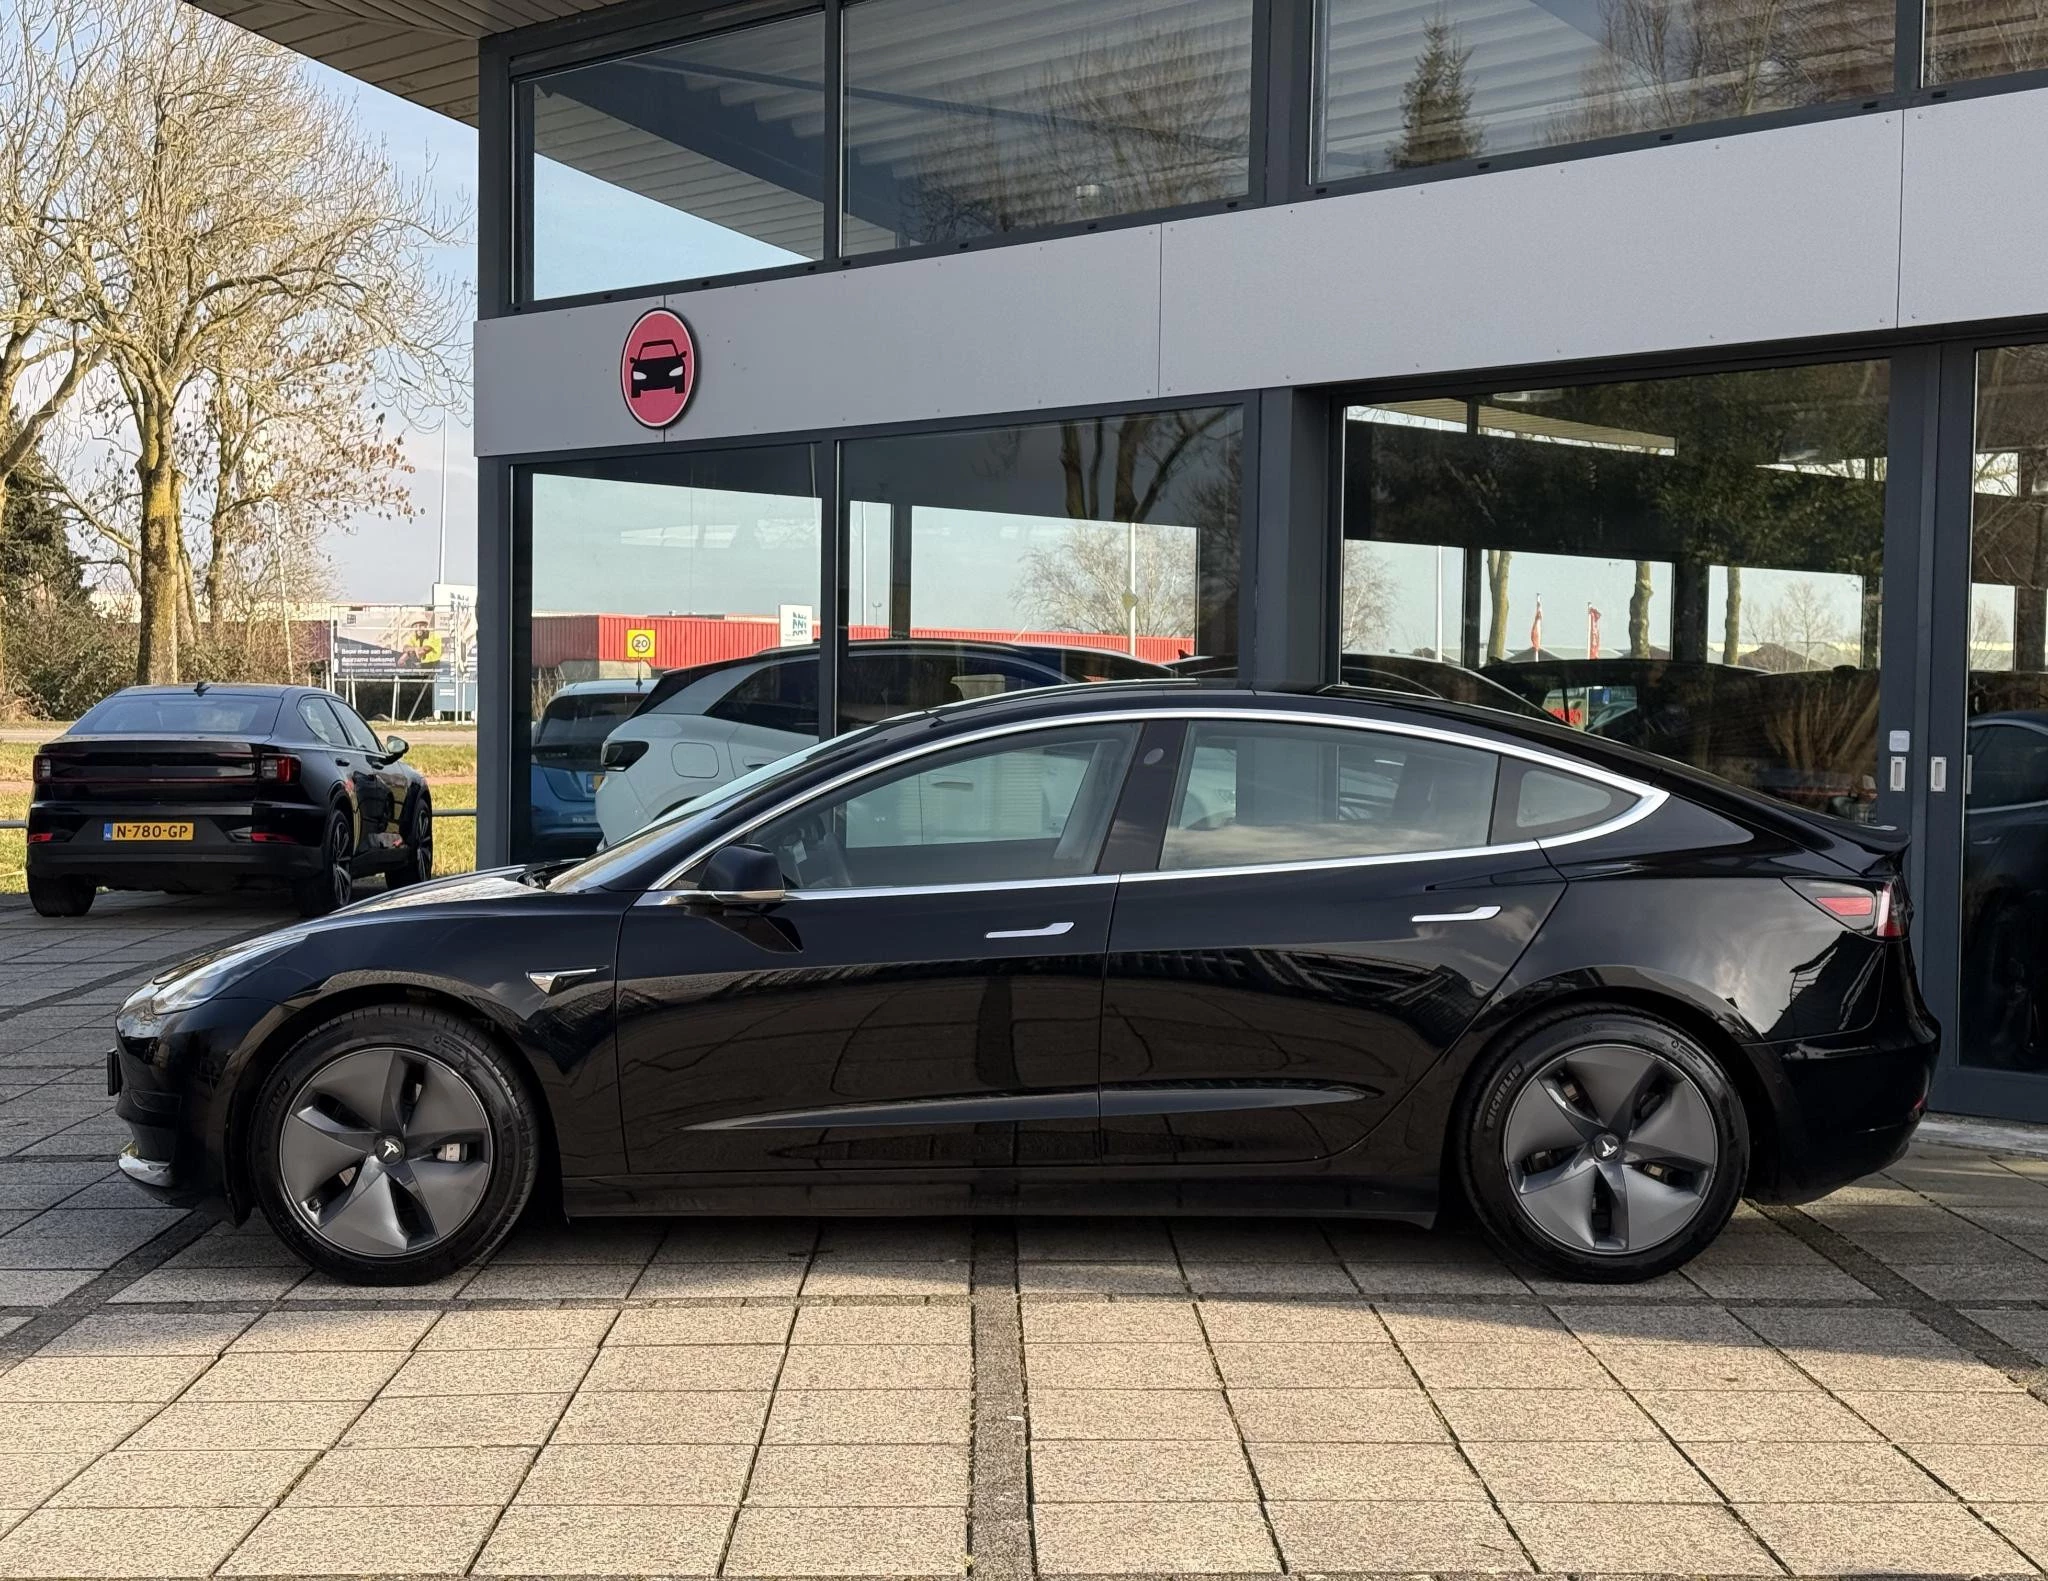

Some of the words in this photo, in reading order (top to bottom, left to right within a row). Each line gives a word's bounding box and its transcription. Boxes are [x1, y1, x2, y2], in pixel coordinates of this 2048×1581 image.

[635, 639, 648, 648] 20
[116, 825, 188, 838] N-780-GP
[1486, 1064, 1521, 1128] MICHELIN
